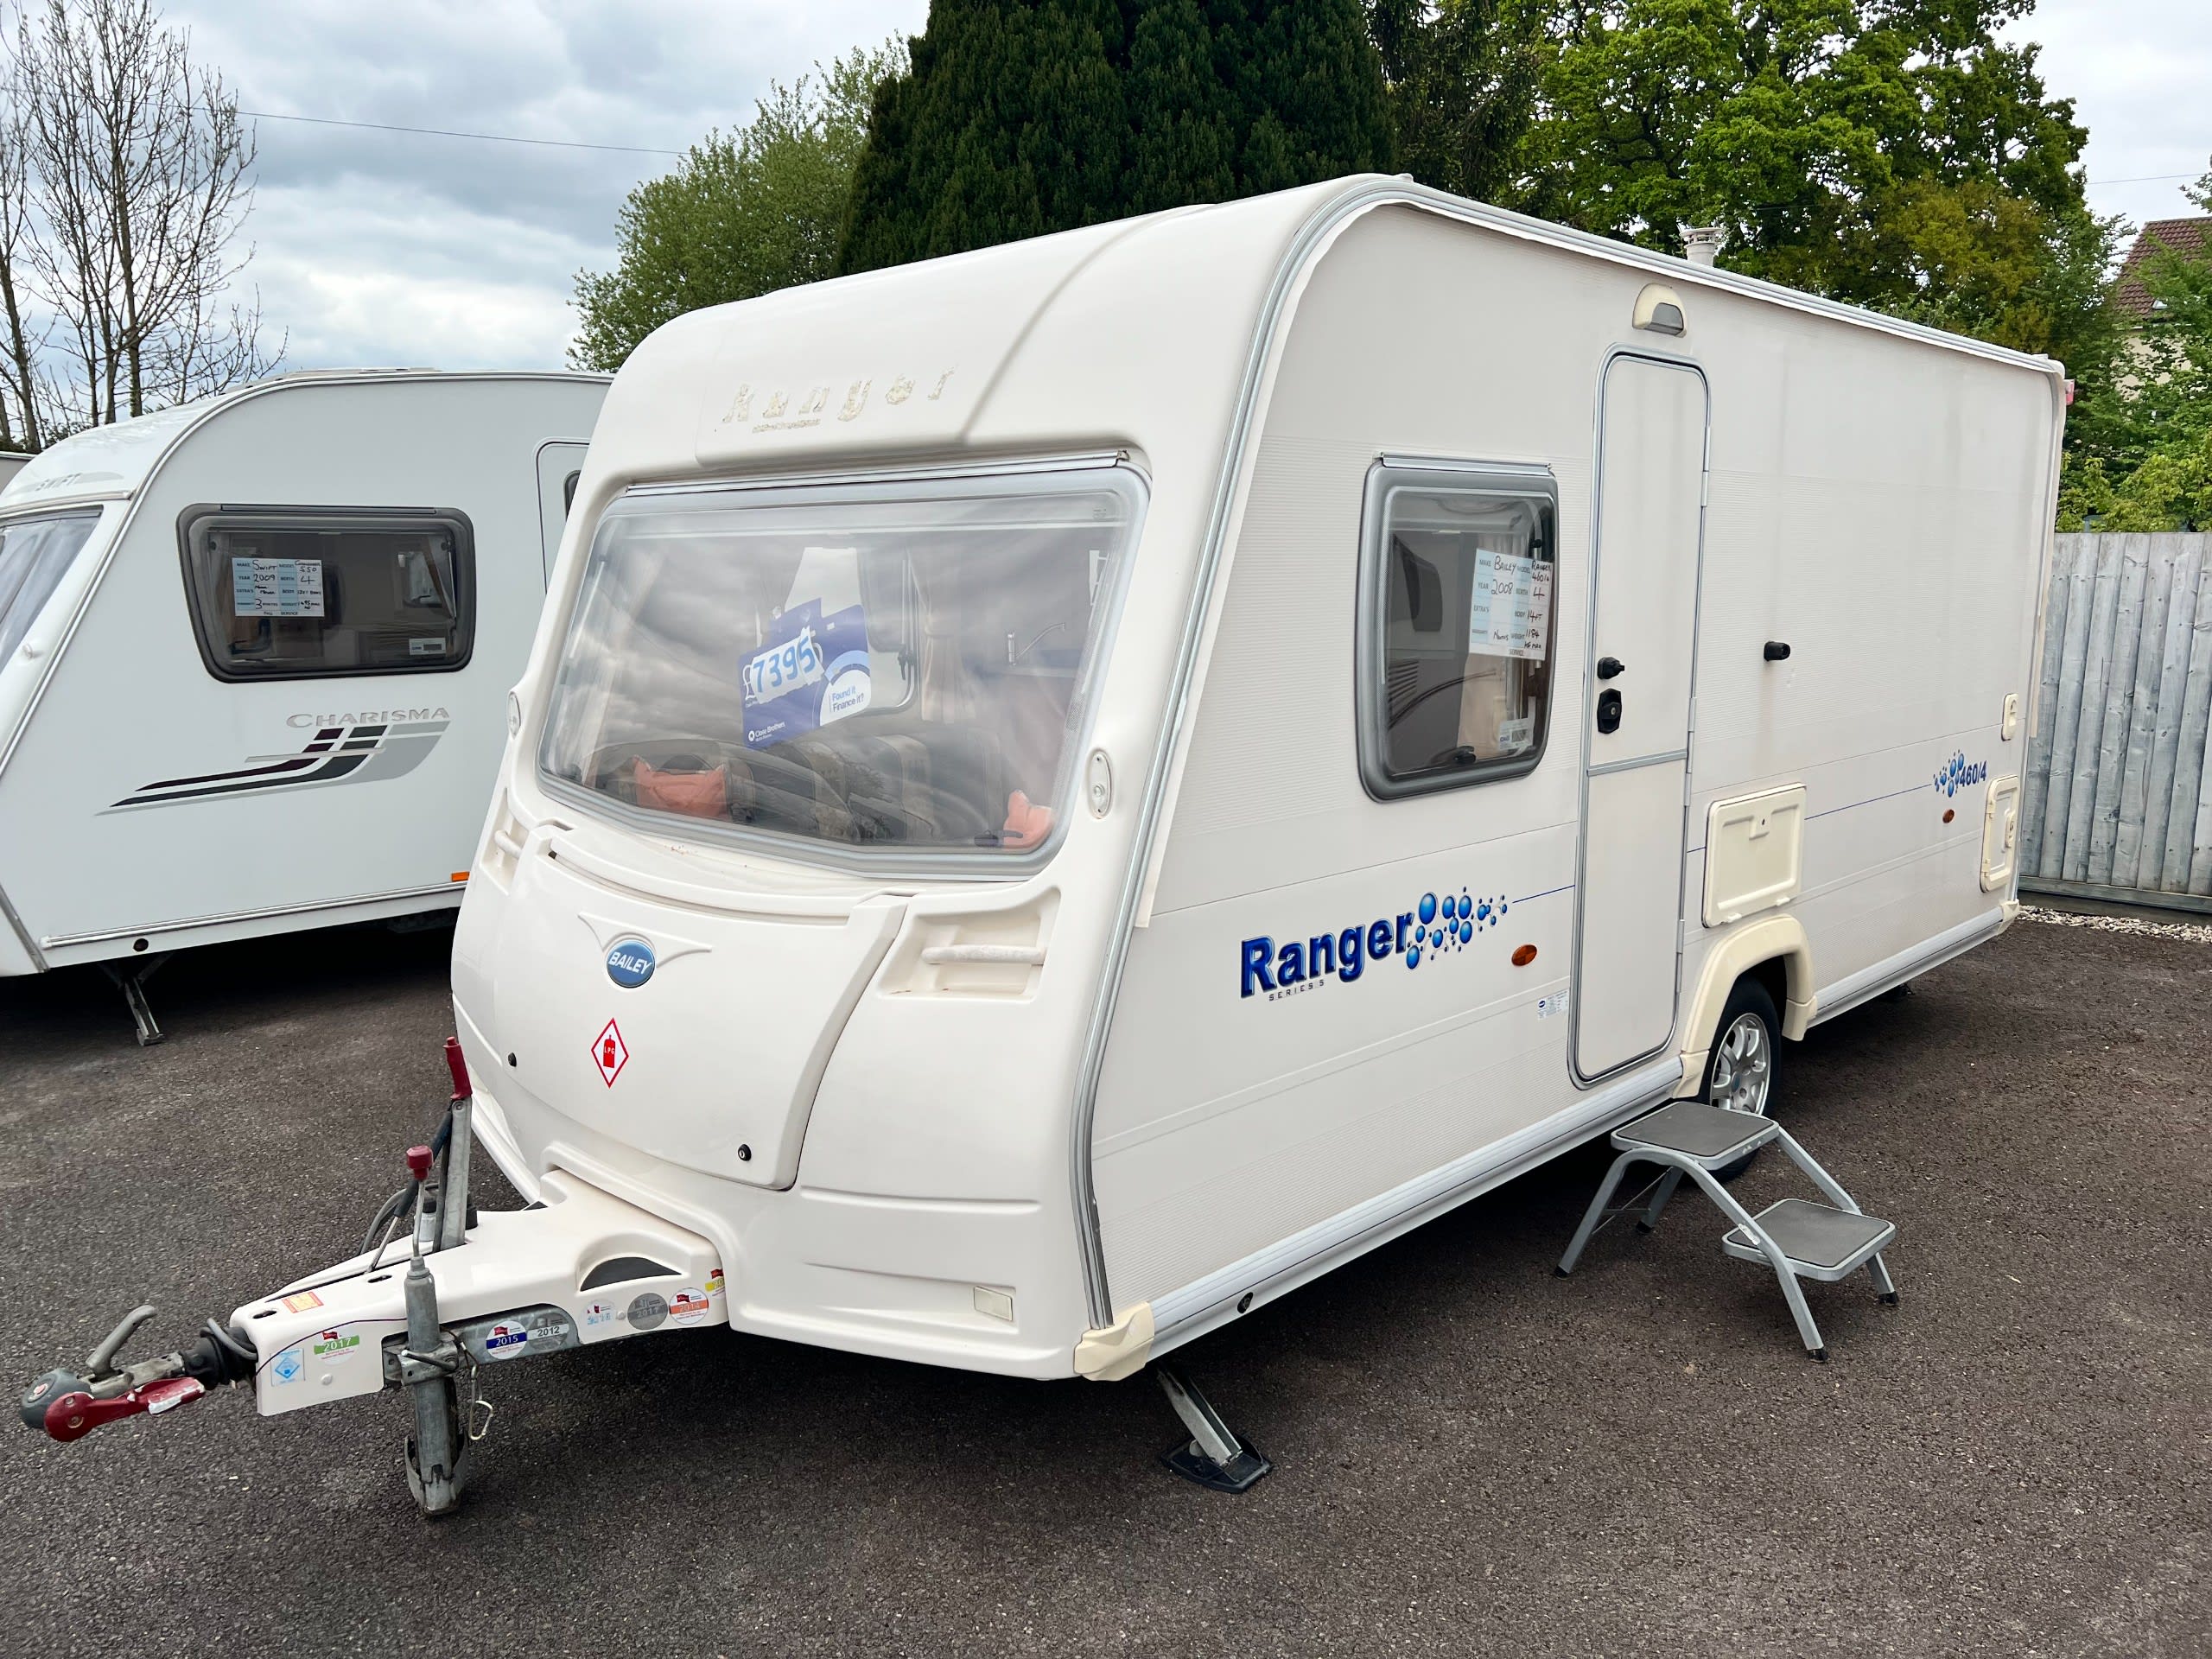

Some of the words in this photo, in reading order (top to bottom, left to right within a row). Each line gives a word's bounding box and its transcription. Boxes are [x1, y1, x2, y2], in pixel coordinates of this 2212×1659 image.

[35, 473, 82, 491] SWIFT
[253, 574, 276, 582] 2009
[301, 575, 315, 584] 4
[1491, 579, 1514, 594] 2008
[1534, 587, 1545, 600] 4
[255, 598, 263, 610] 3
[832, 688, 851, 701] Found
[833, 697, 856, 712] Finance
[855, 692, 864, 705] it?
[286, 707, 450, 728] CHARISMA
[754, 728, 767, 737] Close
[1959, 760, 1987, 787] 460/4
[608, 951, 653, 975] BAILEY
[1241, 912, 1415, 999] Ranger
[1268, 982, 1313, 1001] SERIES
[604, 1046, 615, 1055] LPG
[537, 1326, 560, 1337] 2012
[324, 1338, 351, 1352] 2017
[496, 1335, 518, 1346] 2015
